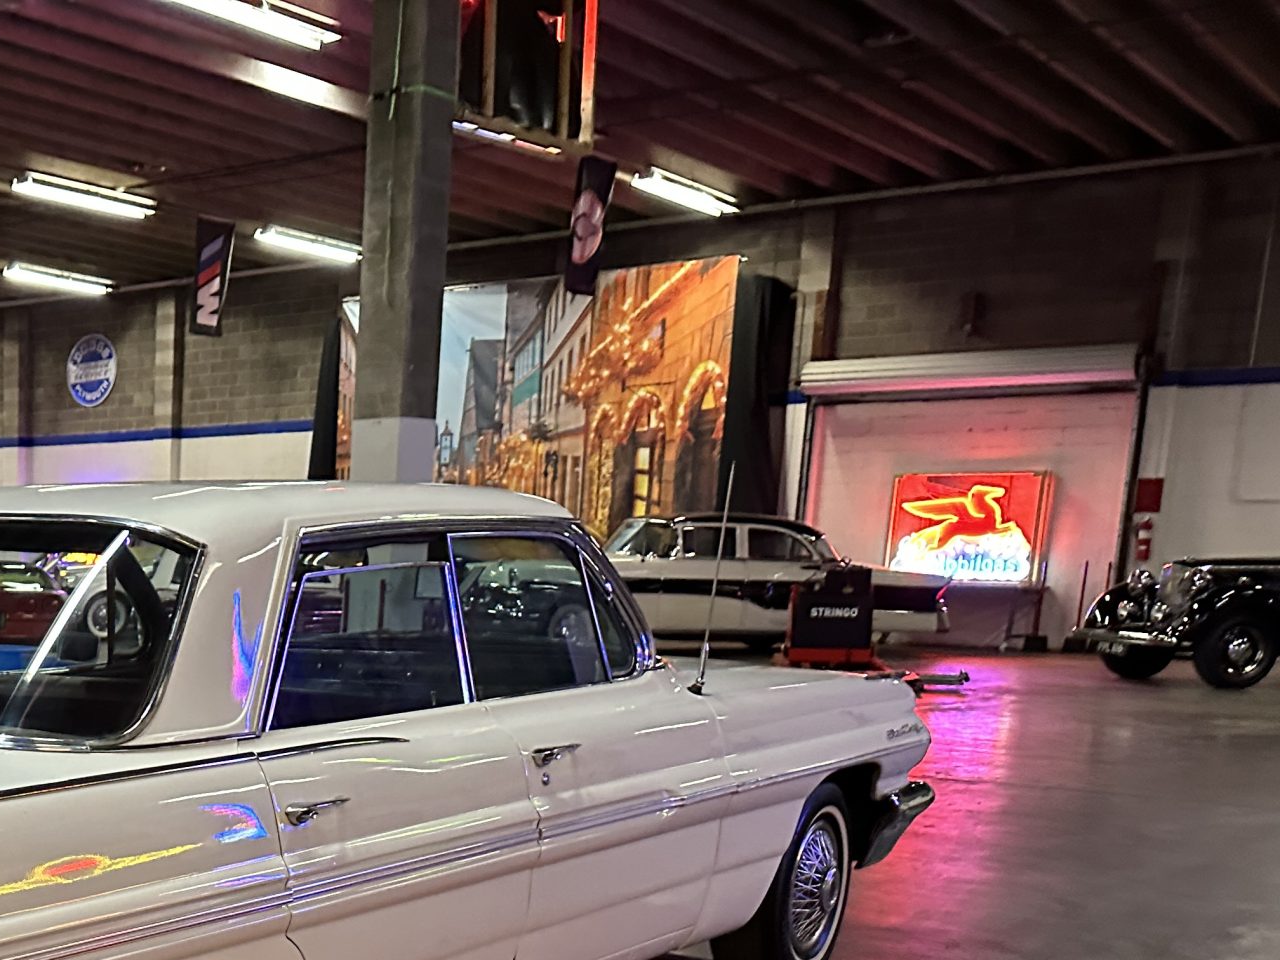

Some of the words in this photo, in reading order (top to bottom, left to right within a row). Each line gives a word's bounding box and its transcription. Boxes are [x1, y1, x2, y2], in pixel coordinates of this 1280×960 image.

[73, 339, 111, 362] DODGE
[75, 380, 109, 401] PLYMOUTH
[810, 606, 859, 618] STRINGO
